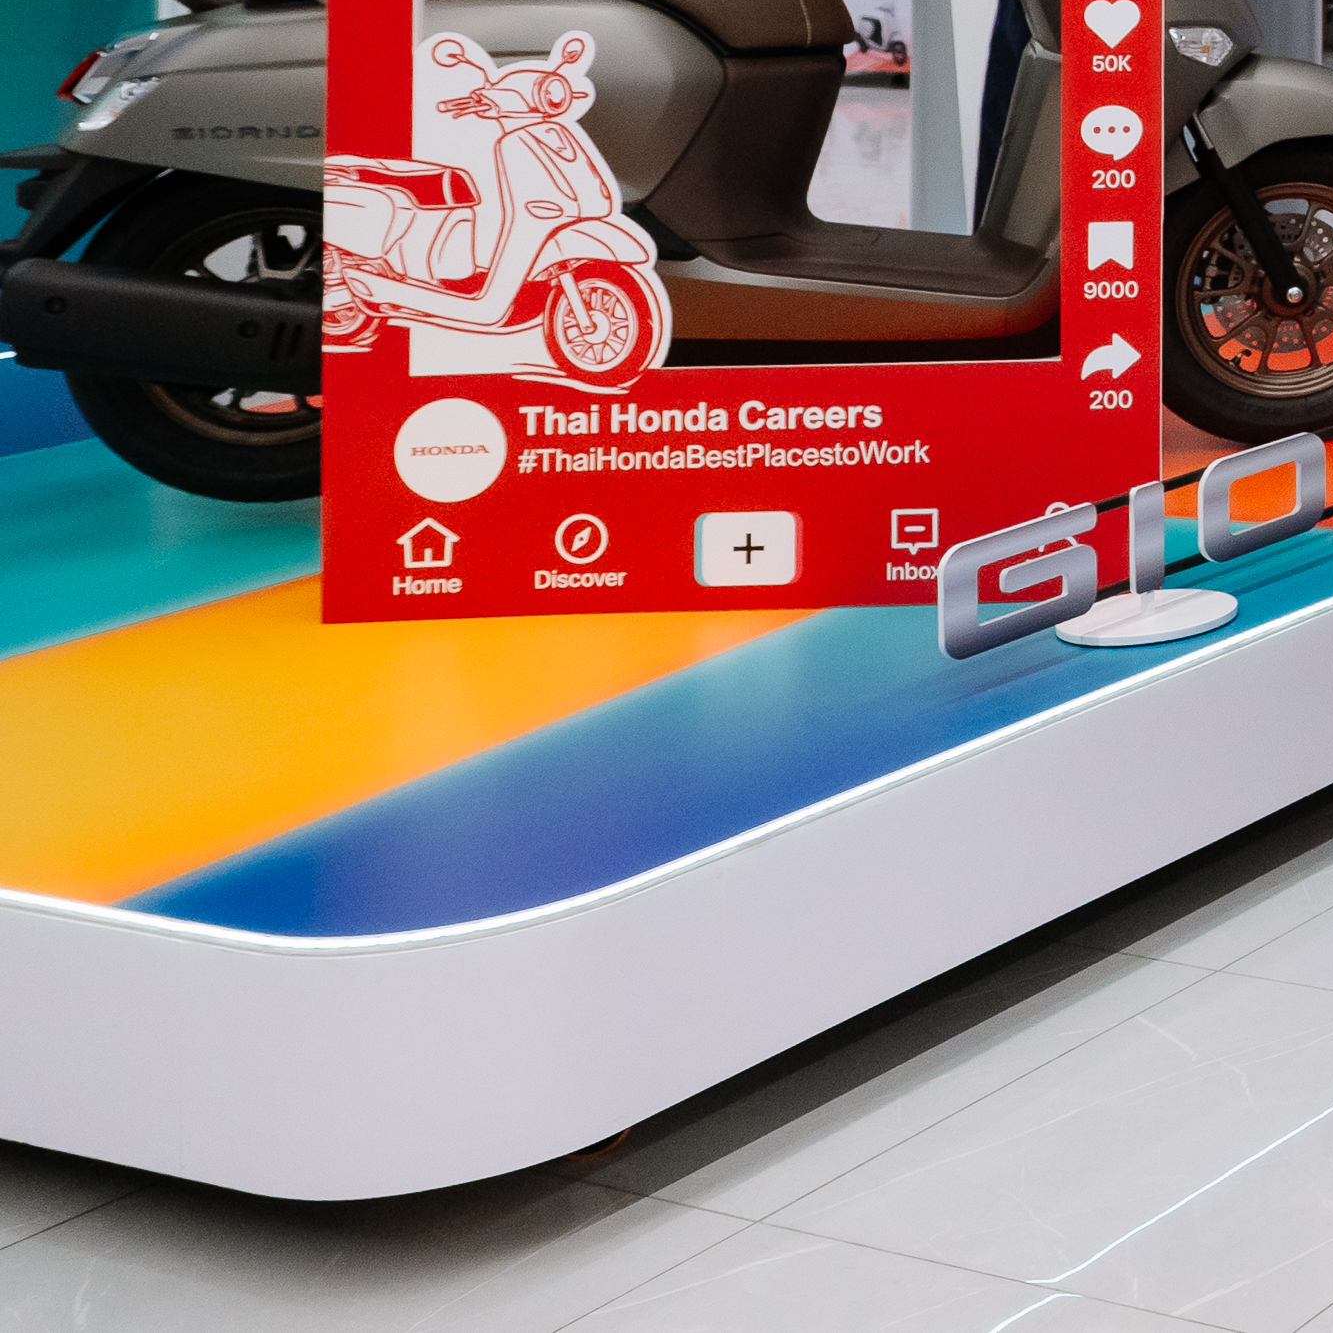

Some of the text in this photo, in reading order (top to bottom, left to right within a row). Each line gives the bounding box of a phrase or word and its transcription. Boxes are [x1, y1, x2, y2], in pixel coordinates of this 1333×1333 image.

[1092, 54, 1132, 73] 50K
[1091, 169, 1137, 189] 200
[1083, 280, 1140, 300] 9000
[1089, 389, 1134, 410] 200
[518, 398, 884, 436] Thai Honda Careers
[410, 444, 490, 457] HONDA
[517, 439, 931, 474] #ThaiHondaBestPlacestoWork
[534, 568, 628, 590] Discover
[886, 561, 940, 581] Inbox
[392, 574, 463, 596] Home
